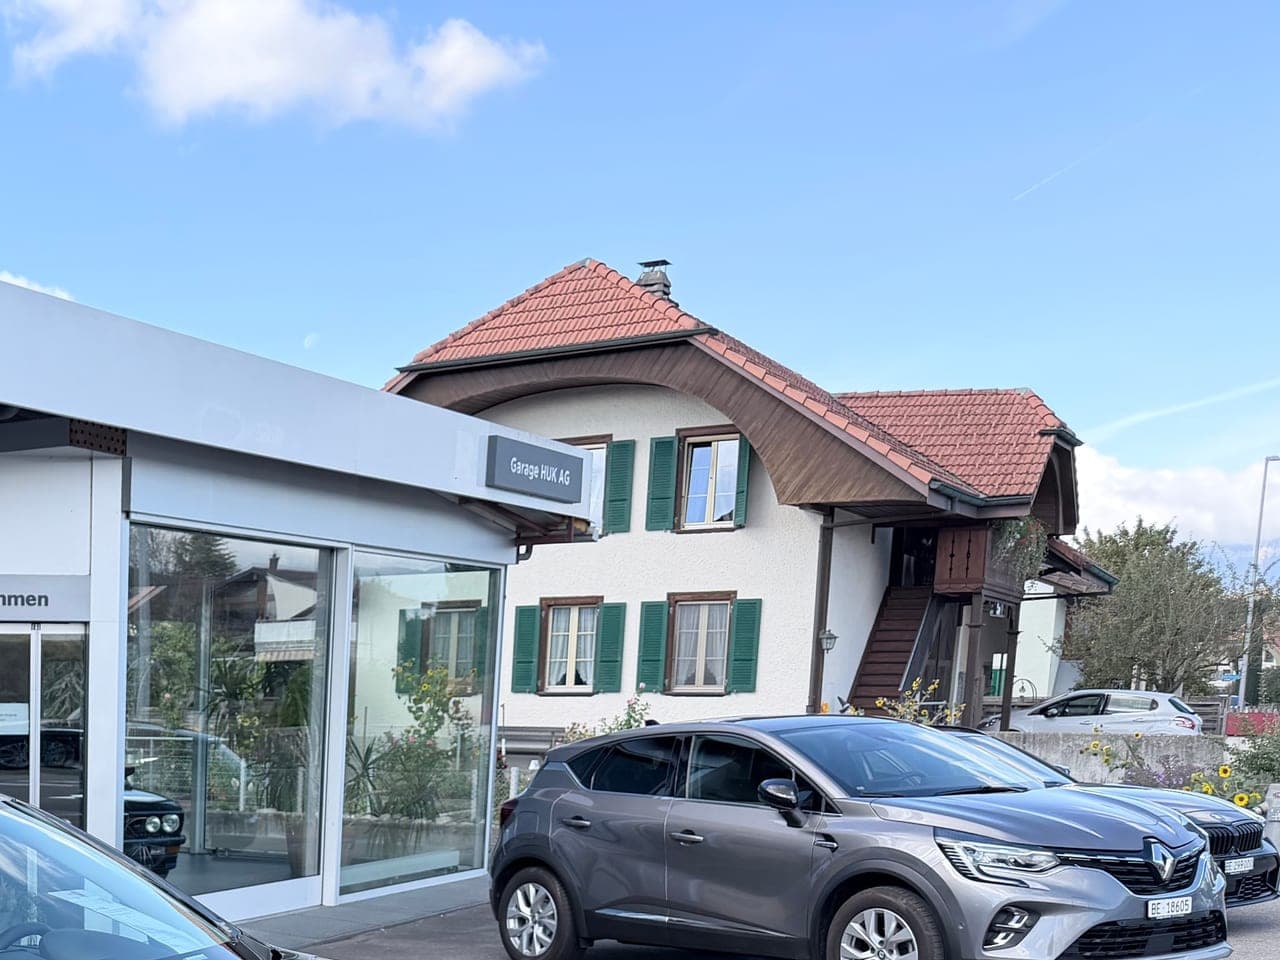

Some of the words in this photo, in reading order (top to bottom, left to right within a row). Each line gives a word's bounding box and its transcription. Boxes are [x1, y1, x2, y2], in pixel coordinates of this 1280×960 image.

[510, 456, 539, 480] Garage
[540, 464, 558, 483] HUK
[558, 469, 570, 486] AG
[1151, 902, 1161, 915] BE
[1167, 899, 1190, 914] 18605
